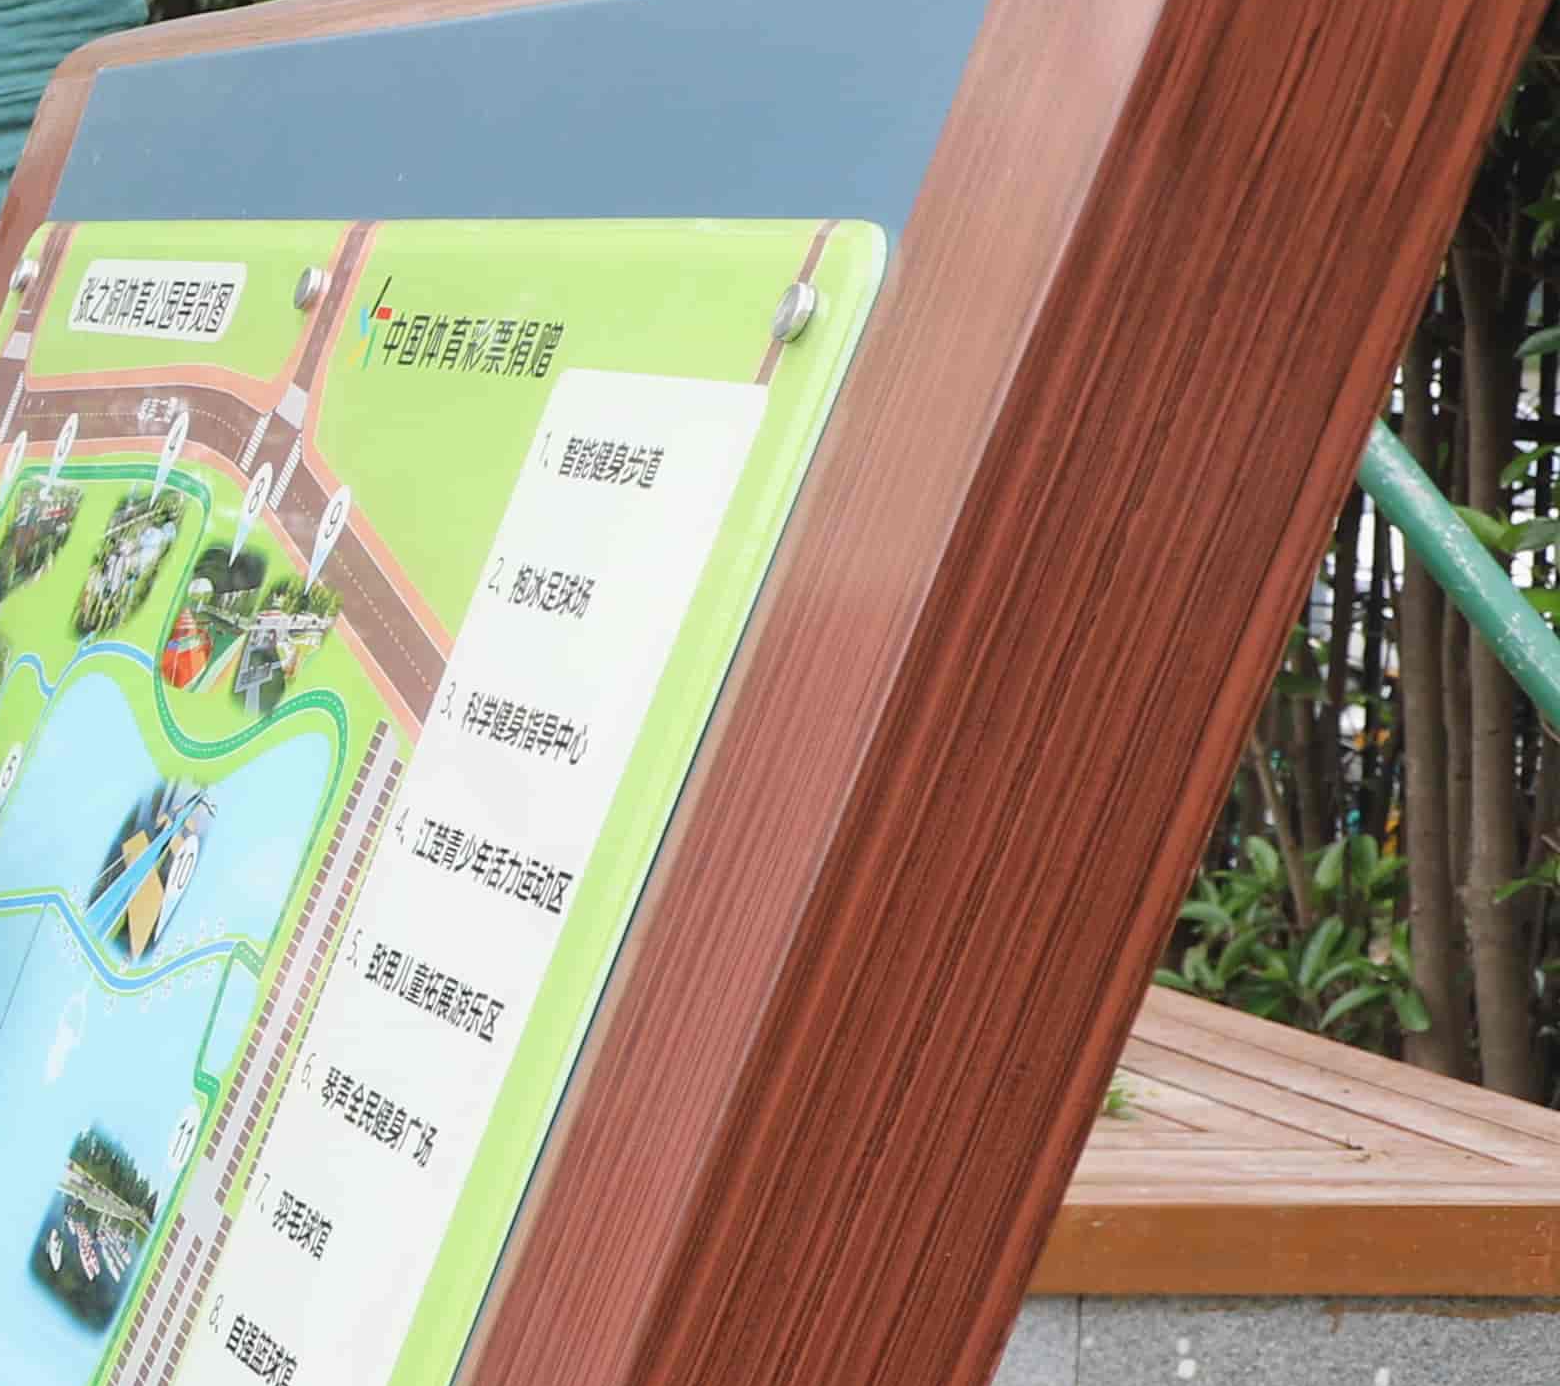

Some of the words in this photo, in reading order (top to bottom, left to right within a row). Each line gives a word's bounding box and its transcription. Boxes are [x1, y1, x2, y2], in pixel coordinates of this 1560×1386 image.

[74, 277, 236, 335] 张之洞体育公园导览图
[382, 312, 565, 379] 中国体育彩票捐赠
[248, 478, 264, 514] 8
[323, 501, 342, 539] 9
[173, 853, 195, 891] 10
[173, 1119, 195, 1162] 11
